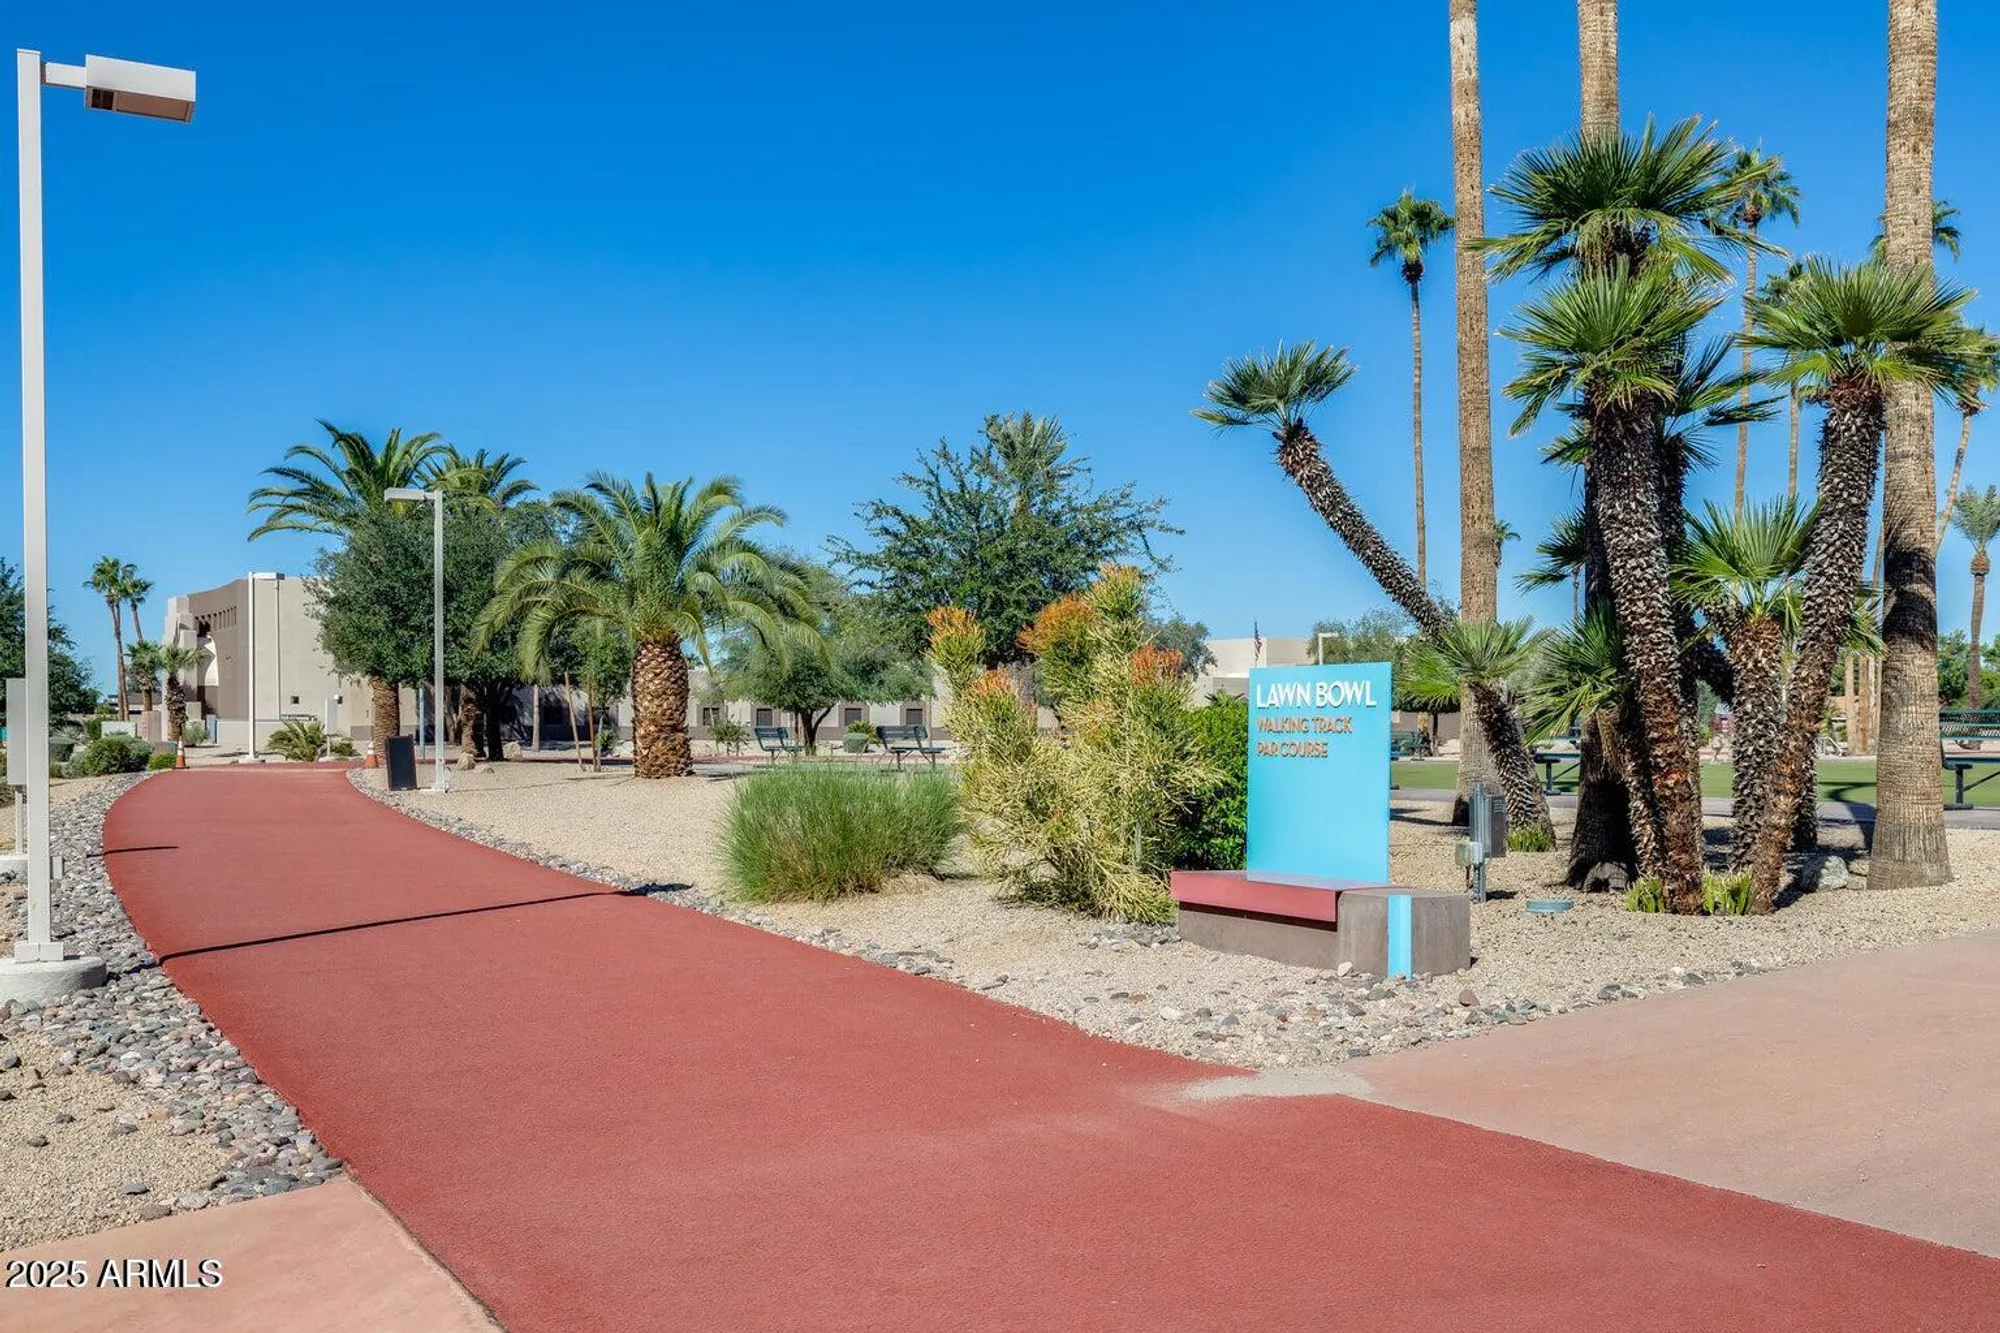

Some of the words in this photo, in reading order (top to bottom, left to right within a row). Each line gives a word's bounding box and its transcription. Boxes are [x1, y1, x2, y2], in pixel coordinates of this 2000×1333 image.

[1256, 682, 1312, 708] LAWN
[1315, 680, 1377, 708] BOWL
[1257, 717, 1309, 733] WALKING
[1312, 717, 1352, 733] TRACK
[1256, 741, 1279, 757] PAR
[1281, 741, 1329, 758] COURSE
